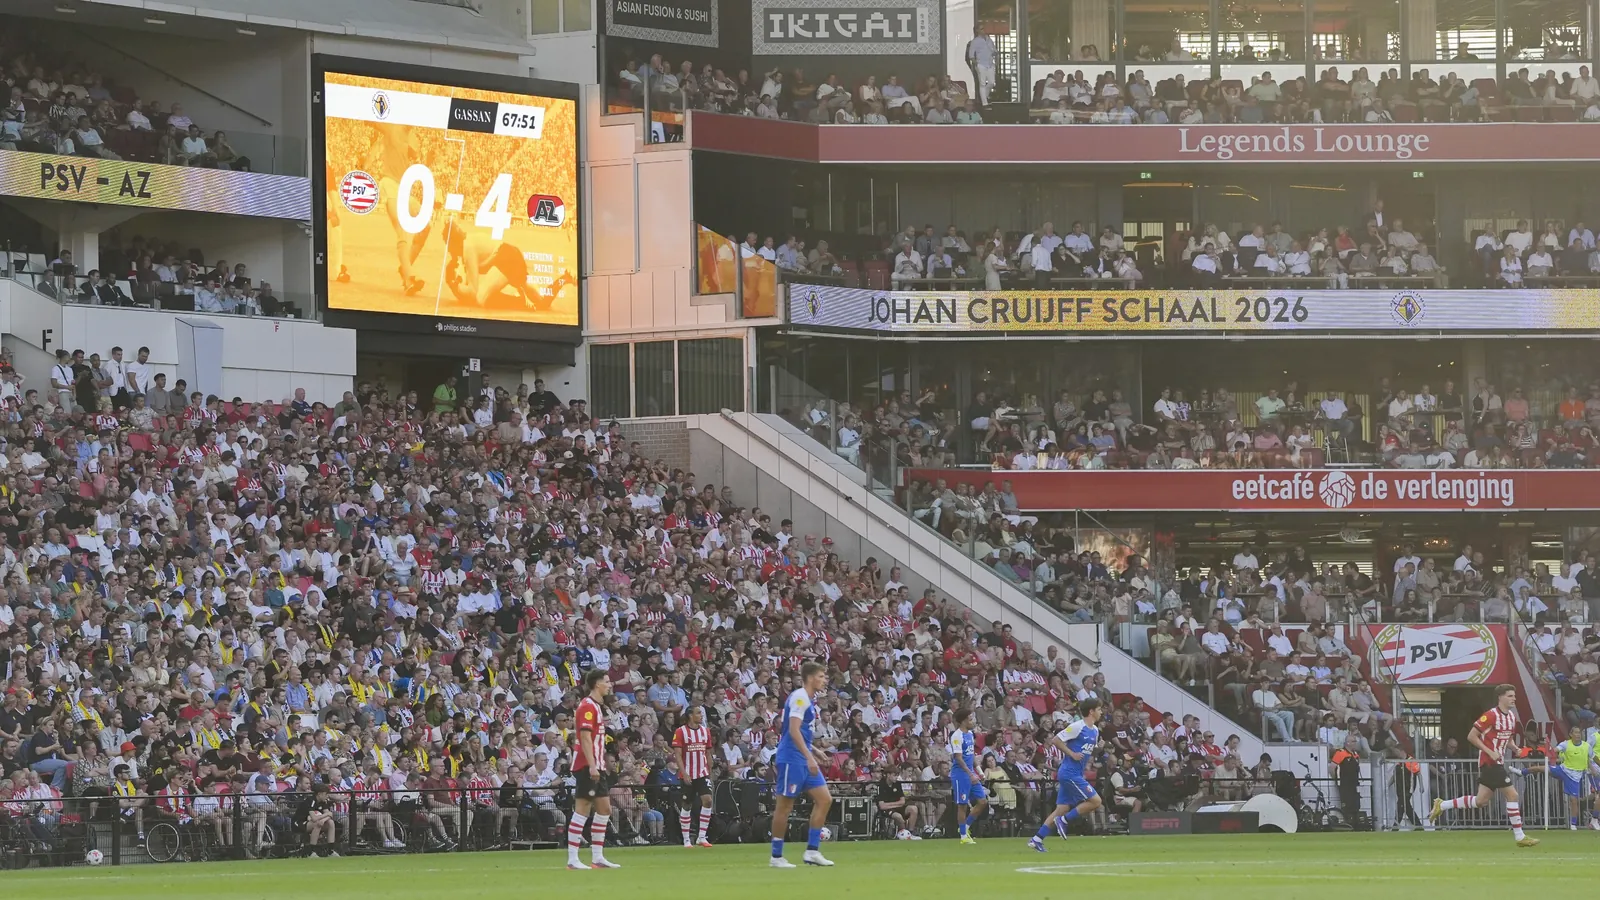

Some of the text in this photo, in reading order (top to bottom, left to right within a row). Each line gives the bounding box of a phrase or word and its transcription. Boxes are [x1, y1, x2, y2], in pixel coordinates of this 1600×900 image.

[616, 1, 709, 23] ASIAN FUSION & SUSHI
[769, 12, 912, 38] IKIGAI
[454, 108, 491, 123] GASSAN
[502, 112, 536, 130] 67:51
[1178, 127, 1430, 160] Legends Lounge
[40, 162, 87, 193] PSV
[118, 170, 151, 199] AZ
[352, 185, 367, 195] PSV
[397, 164, 435, 233] 0
[474, 173, 513, 241] 4
[534, 199, 560, 223] AZ
[868, 296, 1309, 323] JOHAN CRUIJFF SCHAAL 2026
[42, 329, 53, 352] F
[1232, 471, 1514, 507] eetcafé de verlenging
[1411, 640, 1453, 663] PSV
[1141, 818, 1180, 829] ESPN
